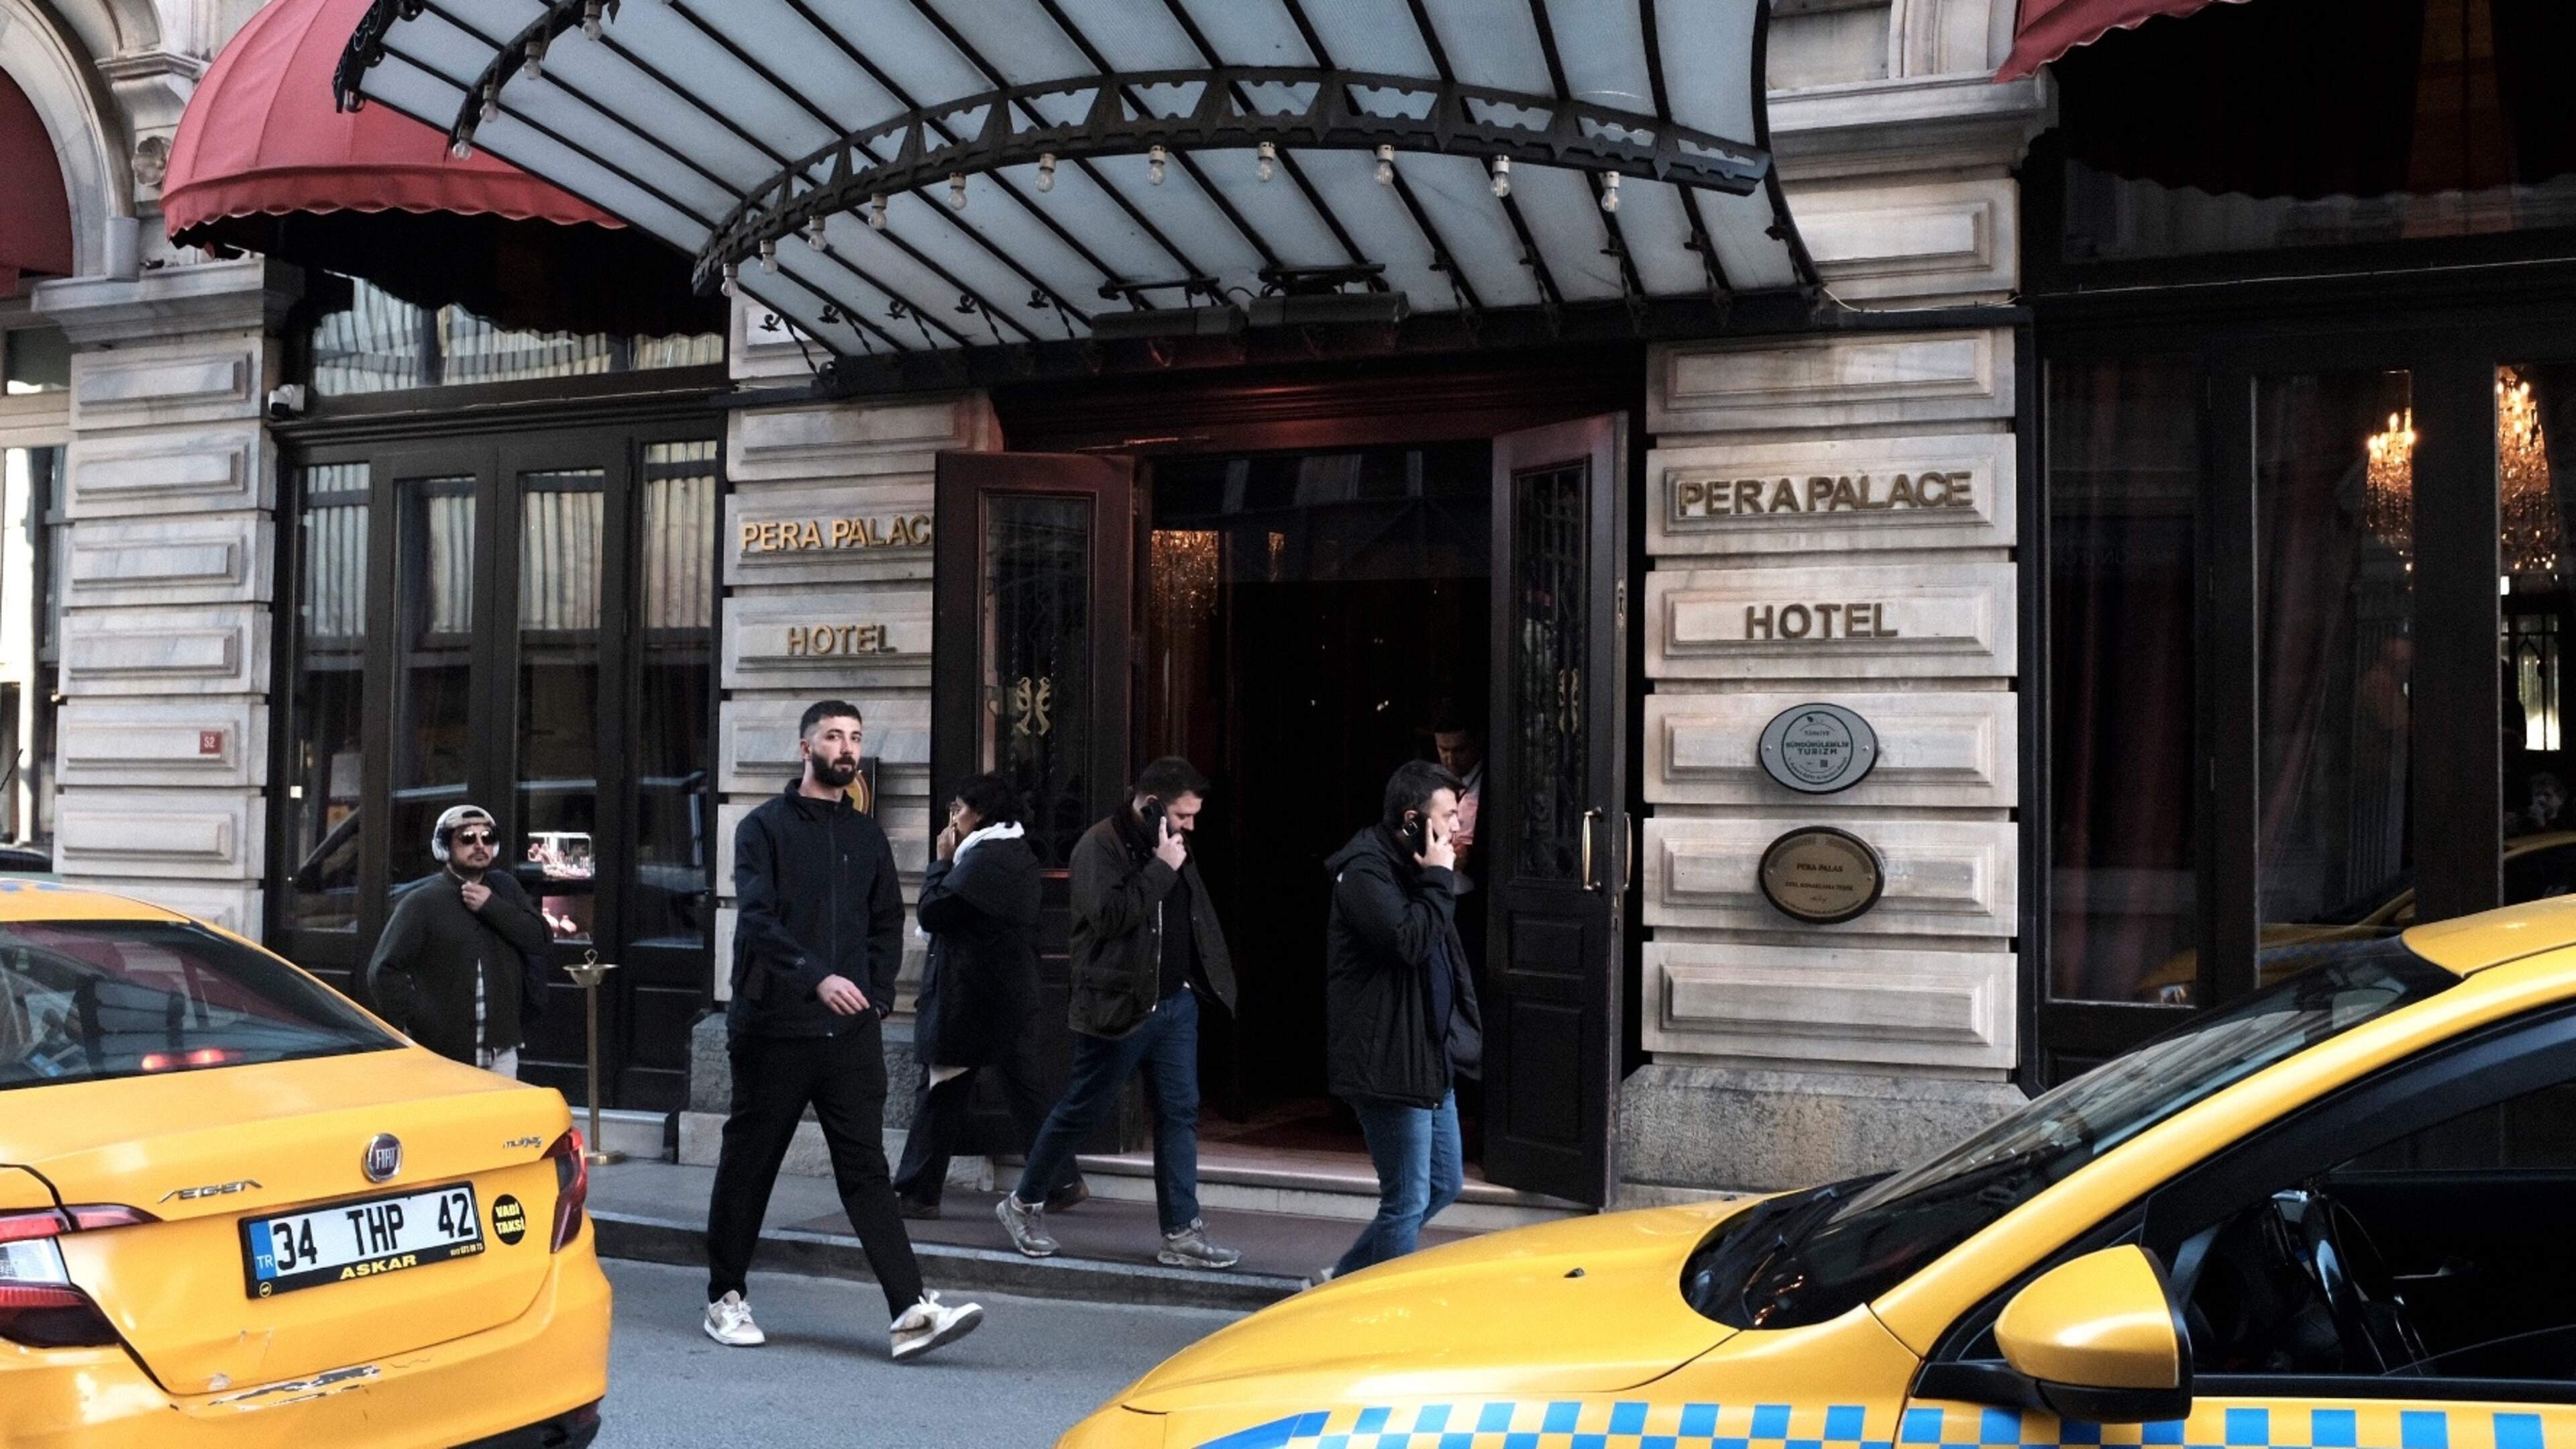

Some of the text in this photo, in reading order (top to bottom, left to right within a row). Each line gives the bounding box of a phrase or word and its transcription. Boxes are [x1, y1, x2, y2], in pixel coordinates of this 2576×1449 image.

[1679, 471, 1974, 515] PERA PALACE
[741, 514, 933, 552] PERA PALAC
[1746, 603, 1898, 639] HOTEL
[787, 624, 898, 655] HOTEL
[204, 736, 215, 748] 52
[376, 1146, 395, 1169] FIAT
[272, 1193, 474, 1271] 34 THP 42
[256, 1254, 274, 1270] TR
[340, 1254, 417, 1280] ASKAR
